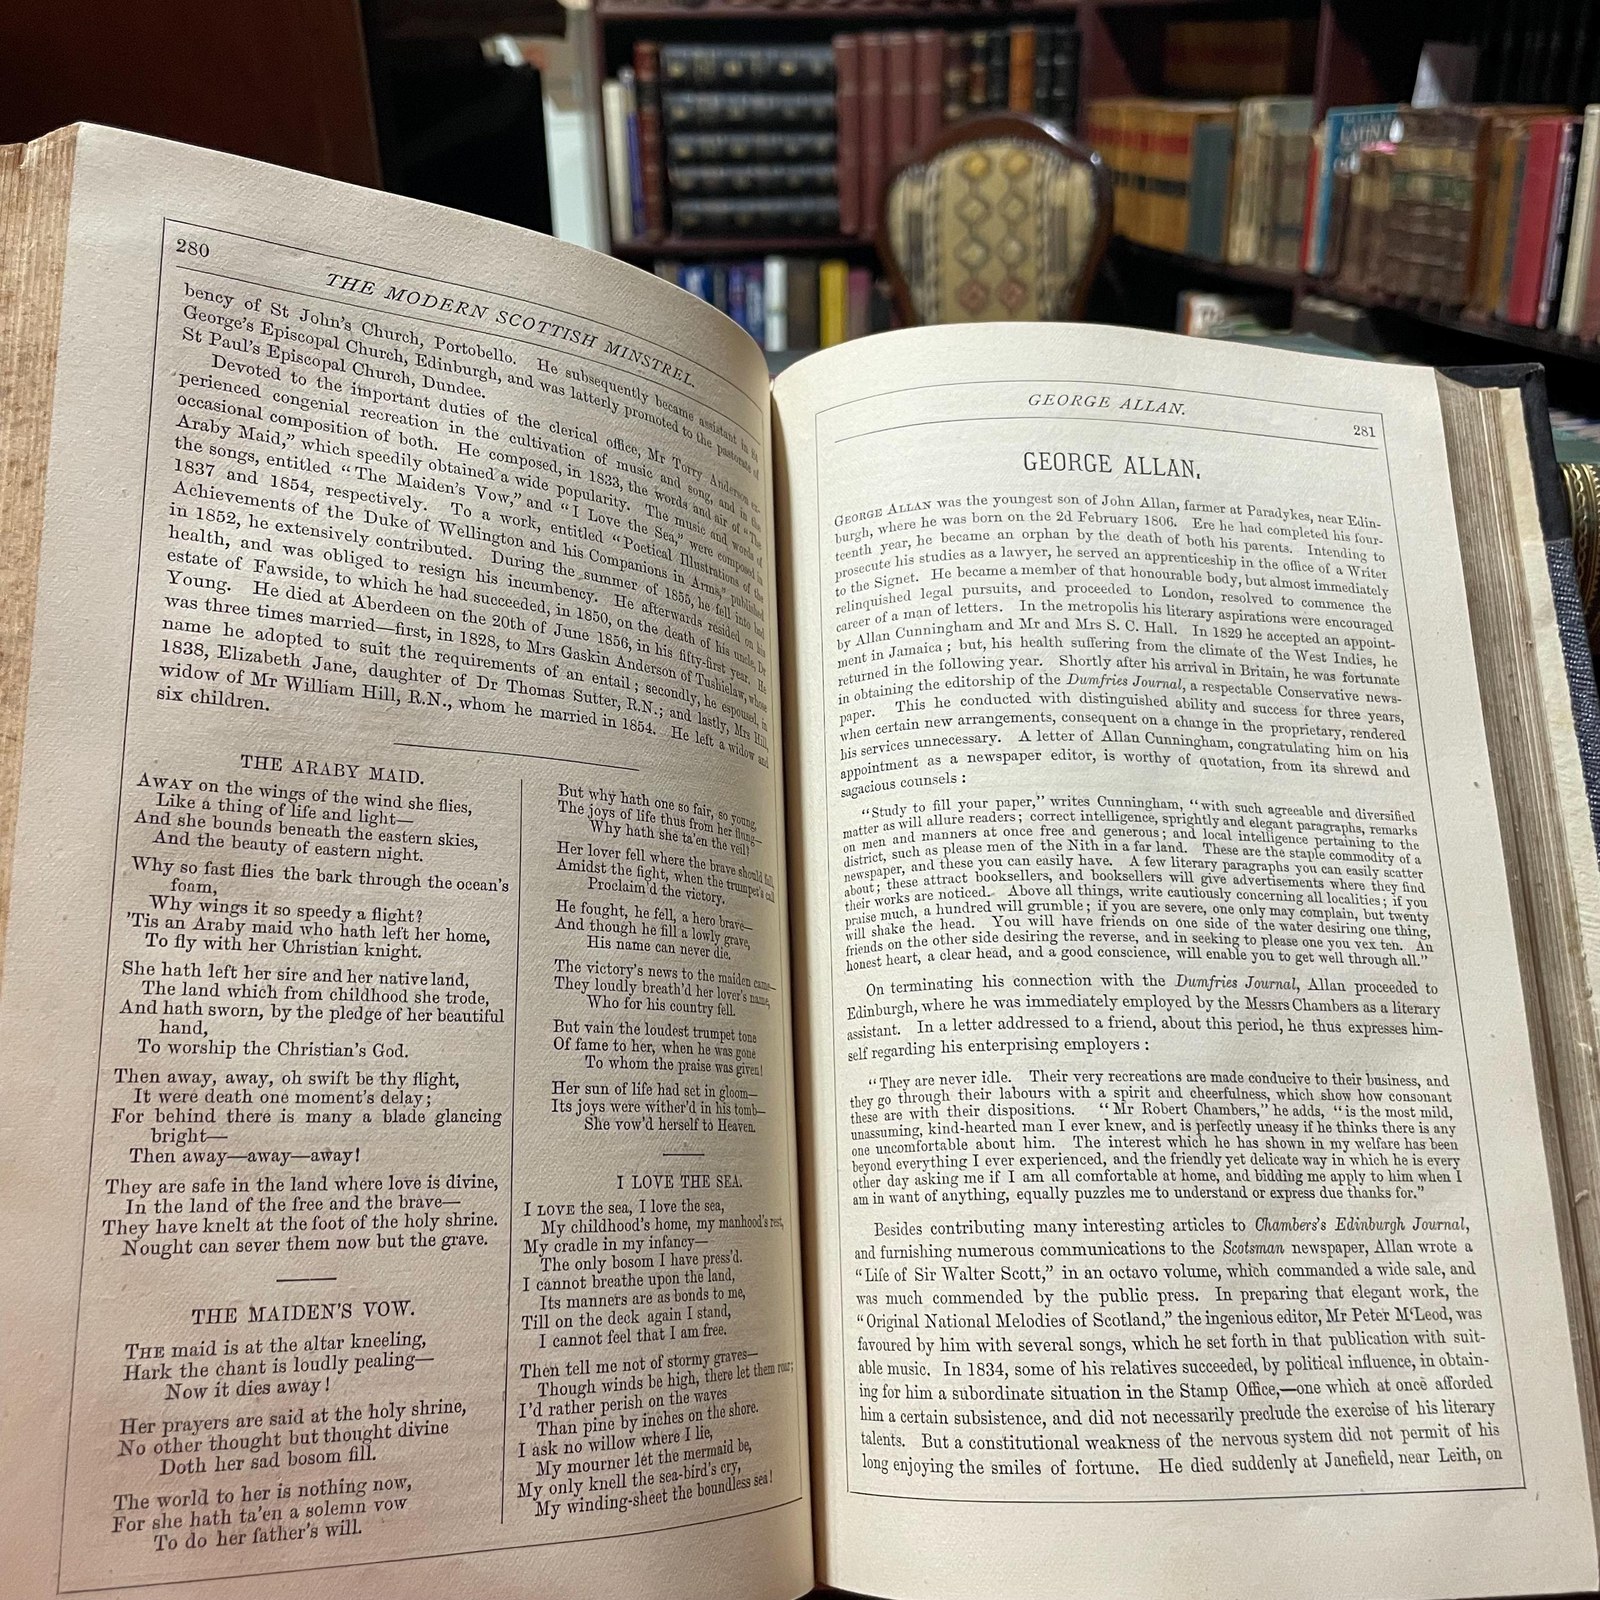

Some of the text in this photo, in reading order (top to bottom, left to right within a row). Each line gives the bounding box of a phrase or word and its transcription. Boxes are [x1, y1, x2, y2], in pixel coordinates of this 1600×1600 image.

[176, 238, 210, 258] 280
[326, 273, 695, 388] THE MODERN SCOTTISH MINSTREL.
[182, 326, 486, 399] St Paul's Episcopal Church, Dundee.
[1028, 394, 1185, 416] GEORGE ALLAN.
[1353, 425, 1376, 438] 281
[1024, 452, 1201, 480] GEORGE ALLAN.
[936, 499, 962, 509] was
[966, 494, 988, 506] the
[992, 493, 1053, 508] youngest
[1057, 496, 1080, 505] son
[1084, 494, 1098, 506] of
[1101, 494, 1135, 508] John
[1139, 497, 1180, 513] Allan,
[1184, 499, 1226, 514] farmer
[1230, 505, 1243, 515] at
[1246, 504, 1314, 525] Paradykes,
[1317, 514, 1344, 525] near
[1346, 514, 1382, 529] Edin-
[156, 685, 270, 712] six children.
[240, 754, 424, 785] THE ARABY MAID.
[199, 782, 219, 793] on
[225, 780, 253, 796] the
[258, 784, 306, 804] wings
[312, 789, 329, 802] of
[333, 790, 359, 805] the
[364, 793, 403, 809] wind
[408, 796, 434, 811] she
[438, 798, 472, 817] flies,
[558, 783, 584, 799] But
[588, 788, 617, 806] why
[620, 790, 650, 807] hath
[654, 799, 675, 811] one
[678, 803, 690, 813] so
[693, 802, 714, 821] fair,
[718, 811, 729, 821] so
[587, 876, 725, 907] Proclaim'd the victory.
[866, 972, 1438, 997] On terminating his connection with the Dumfries Journal, Allan proceeded to
[586, 994, 736, 1018] Who for his country fell.
[137, 1038, 409, 1060] To worship the Christian's God.
[114, 1068, 459, 1091] Then away, away, oh swift be thy flight,
[584, 1116, 756, 1133] She vow'd herself to Heaven.
[617, 1173, 743, 1190] I LOVE THE SEA.
[853, 1185, 1425, 1206] am in want of anything, equally puzzles me to understand or express due thanks for."
[873, 1216, 1470, 1239] Besides contributing many interesting articles to Chambers's Edinburgh Journal,
[191, 1299, 415, 1326] THE MAIDEN'S VOW.
[171, 1340, 217, 1358] maid
[223, 1339, 239, 1356] is
[245, 1339, 263, 1354] at
[269, 1337, 298, 1353] the
[304, 1335, 345, 1351] altar
[350, 1331, 426, 1351] kneeling,
[158, 1444, 376, 1476] Doth her sad bosom fill.
[862, 1446, 1503, 1479] long enjoying the smiles of fortune. He died suddenly at Janefield, near Leith, on
[534, 1469, 773, 1520] My winding-sheet the boundless sea!
